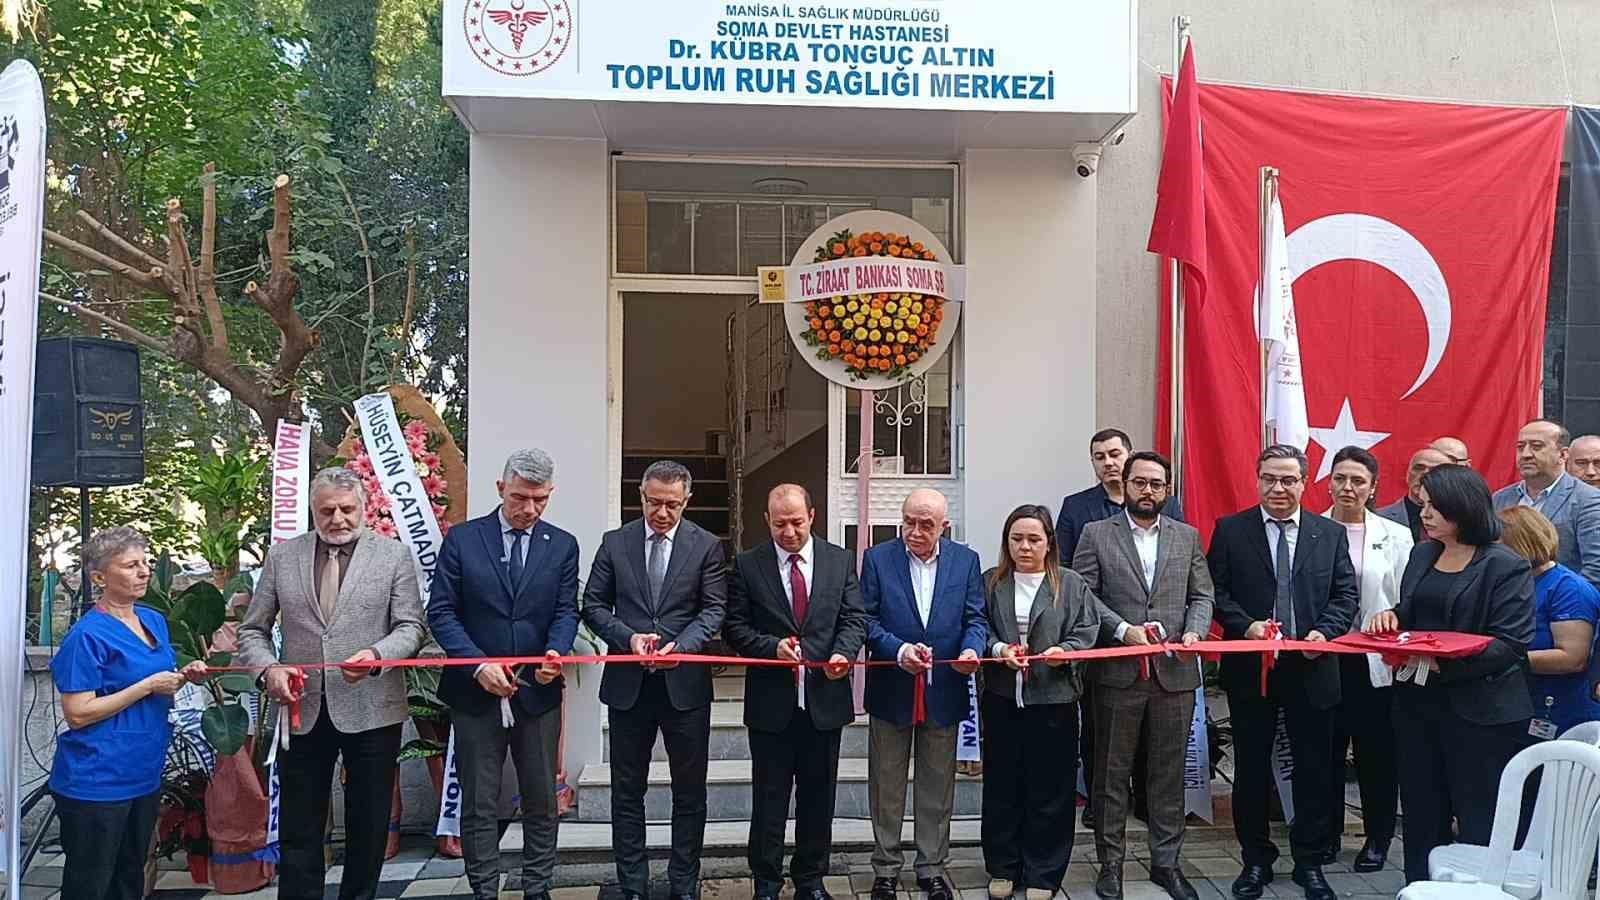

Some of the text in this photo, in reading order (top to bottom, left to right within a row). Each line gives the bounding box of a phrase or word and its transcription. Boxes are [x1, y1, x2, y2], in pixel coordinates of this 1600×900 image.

[726, 3, 940, 22] MANİSA İL SAĞLIK MÜDÜRLÜĞÜ
[717, 21, 949, 43] SOMA DEVLET HASTANESİ
[669, 39, 701, 59] Dr.
[711, 37, 800, 62] KÜBRA
[921, 47, 994, 67] ALTIN
[607, 64, 1055, 100] TOPLUM RUH SAĞLIĞI MERKEZİ
[817, 265, 849, 293] ZİRAAT
[856, 265, 902, 289] BANKASI
[906, 266, 933, 290] SOMA
[276, 425, 302, 471] HAVA
[366, 403, 404, 477] HÜSEYİN
[274, 475, 298, 531] ZORLU
